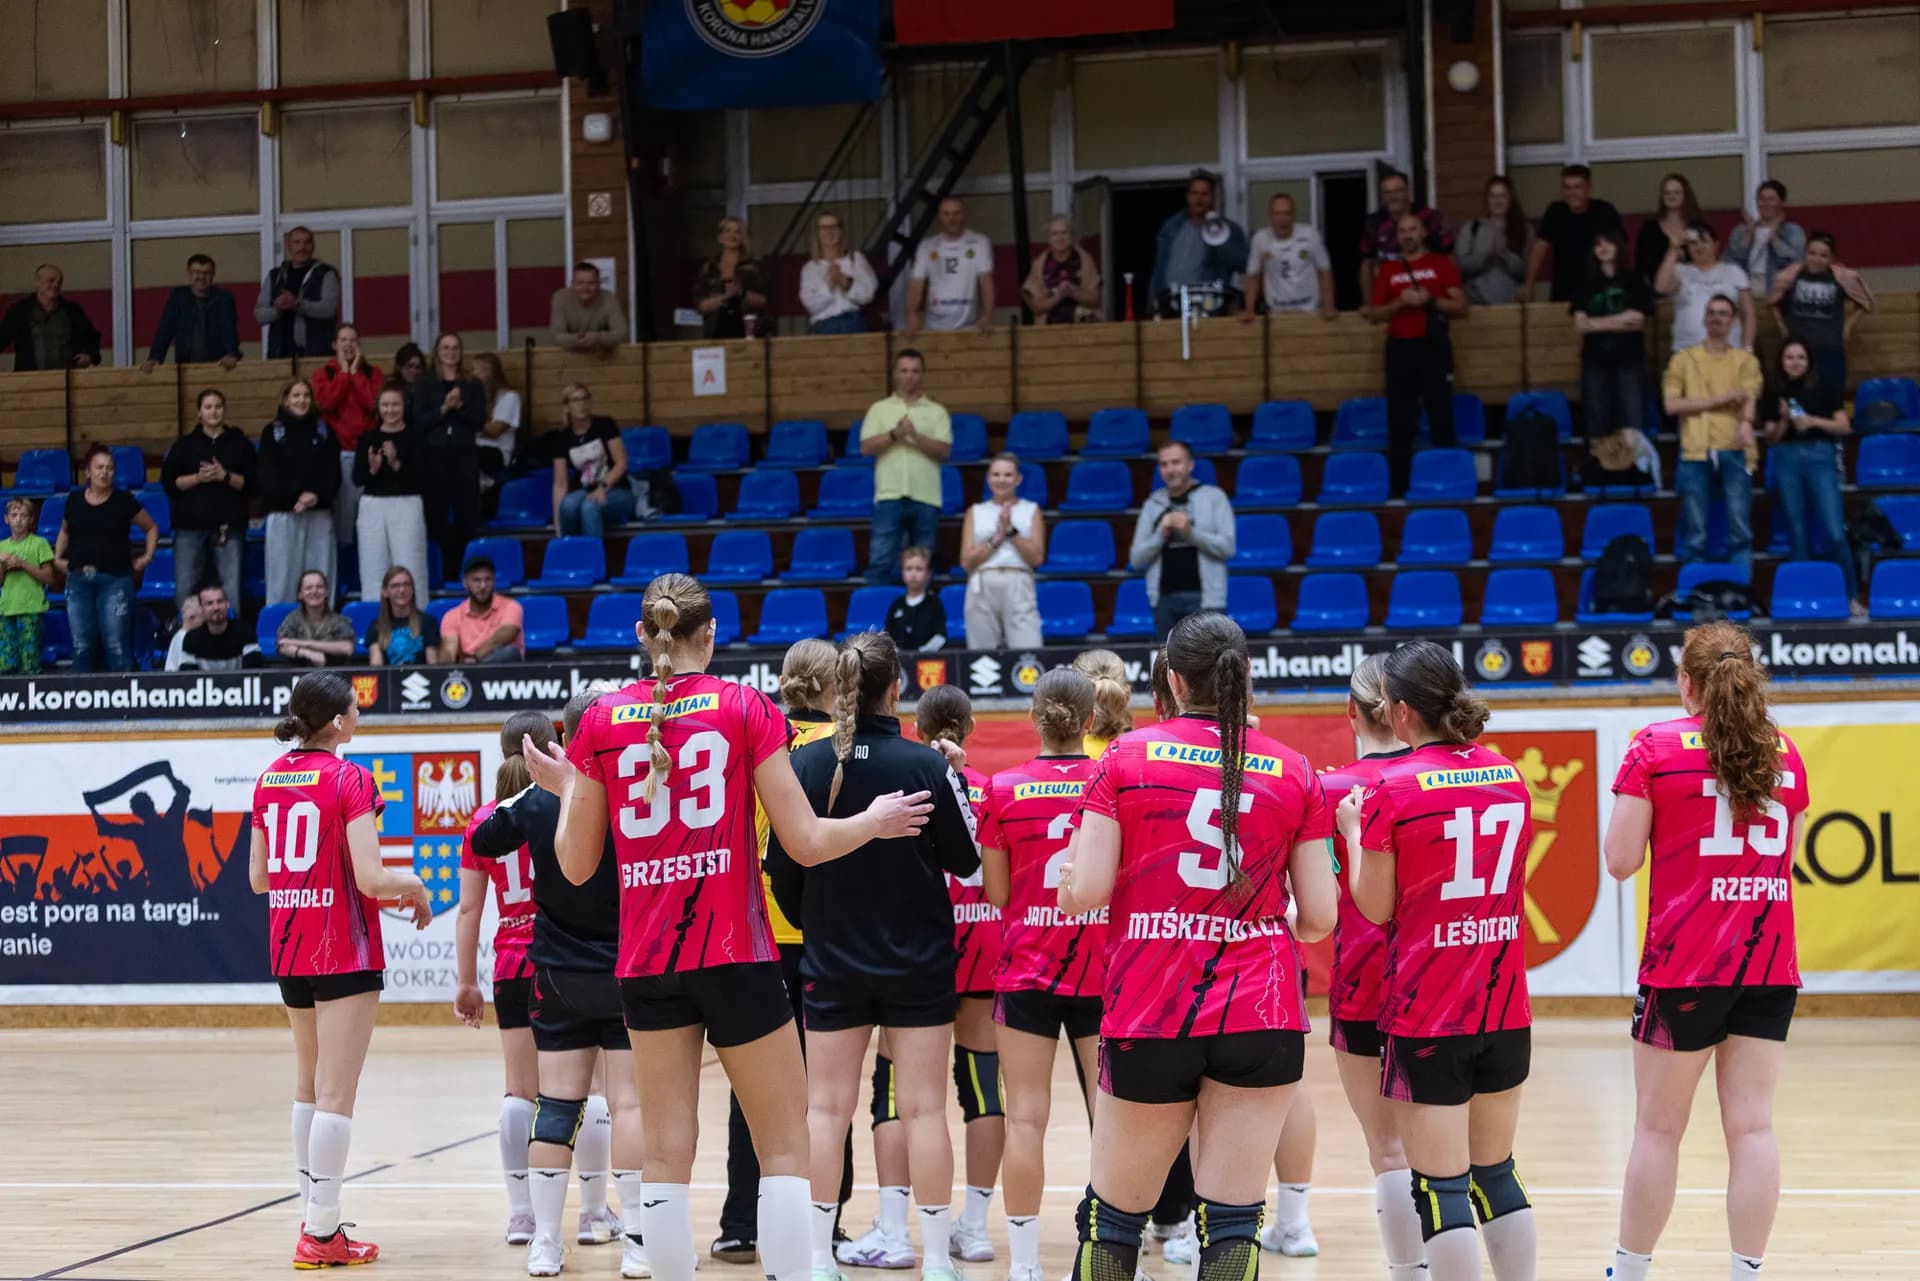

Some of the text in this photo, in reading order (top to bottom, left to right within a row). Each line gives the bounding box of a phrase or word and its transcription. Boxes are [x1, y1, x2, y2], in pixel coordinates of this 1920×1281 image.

[698, 2, 748, 46] KORONA
[269, 773, 315, 785] LEWIATAN
[618, 731, 730, 840] 33
[1446, 767, 1514, 785] LEWIATAN
[1699, 771, 1795, 857] 15
[262, 801, 320, 873] 10
[1177, 788, 1255, 890] 5
[1440, 802, 1525, 901] 17
[1792, 810, 1920, 886] OL
[496, 850, 536, 905] 1
[621, 848, 731, 889] GRZESIST
[1711, 876, 1788, 902] RZEPKA
[45, 903, 99, 927] pora
[106, 903, 135, 922] na
[143, 898, 220, 926] targi...
[269, 886, 335, 909] OSIADŁO
[0, 933, 52, 956] anie
[1433, 915, 1519, 948] LEŚNIAK
